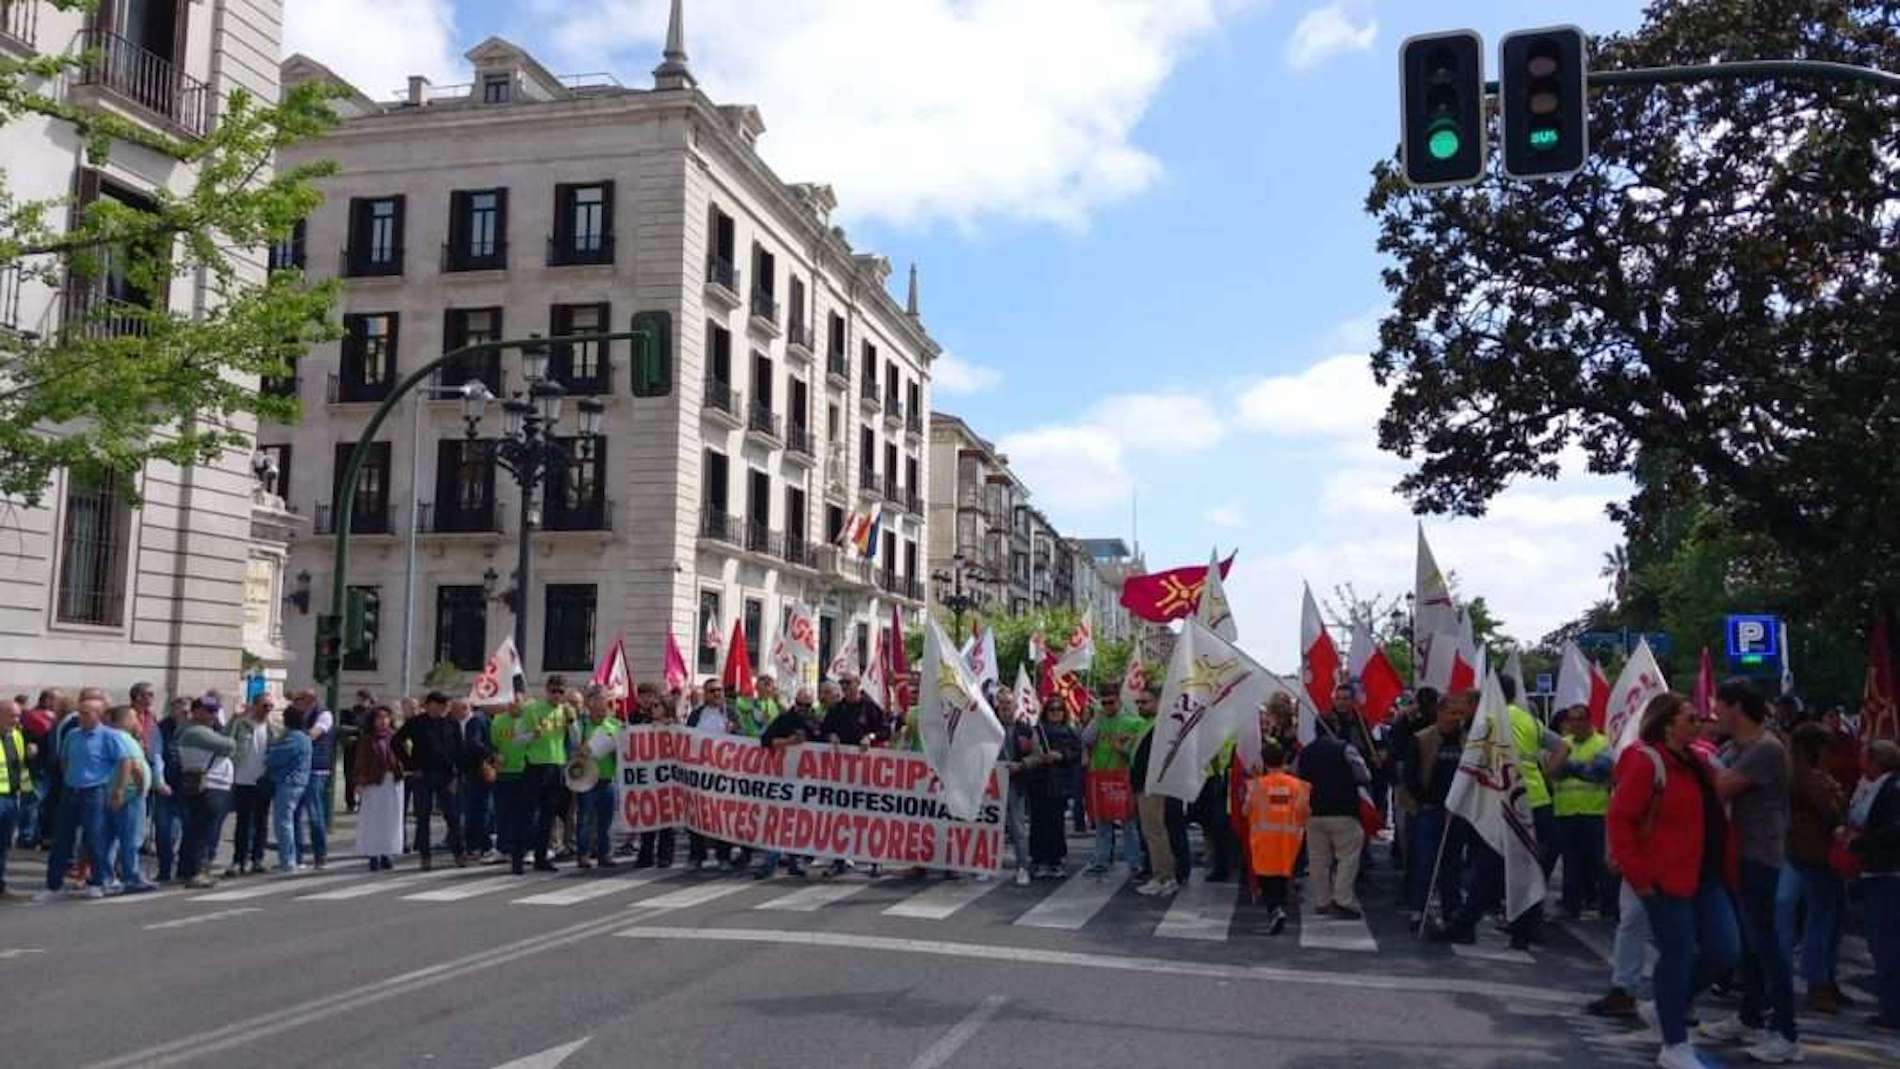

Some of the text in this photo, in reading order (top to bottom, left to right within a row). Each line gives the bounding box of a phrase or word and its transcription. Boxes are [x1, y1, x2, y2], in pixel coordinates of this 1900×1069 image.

[1530, 130, 1557, 144] BUS
[1737, 621, 1764, 653] P
[624, 763, 1001, 824] DE CONDUCTORES PROFESIONAS
[763, 805, 937, 864] REDUCTORES
